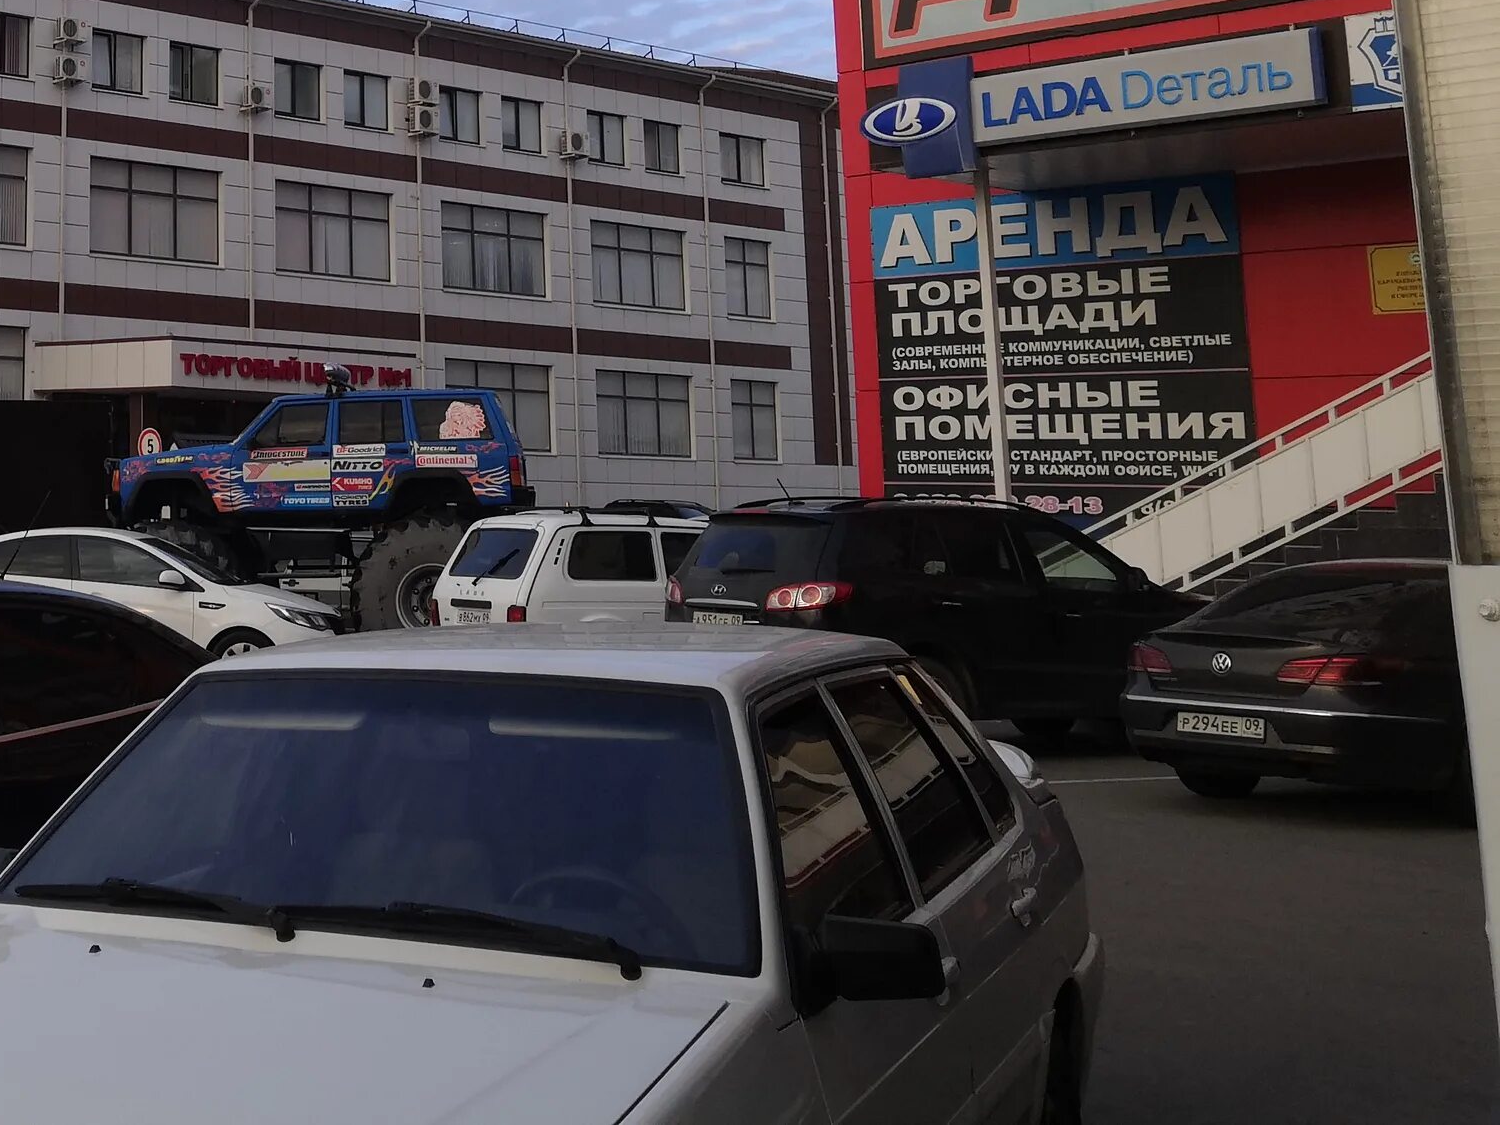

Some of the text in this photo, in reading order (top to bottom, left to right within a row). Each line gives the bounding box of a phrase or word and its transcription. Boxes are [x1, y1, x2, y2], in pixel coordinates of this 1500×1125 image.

[981, 75, 1112, 129] LADA
[879, 184, 1229, 269] АРЕНДА
[1009, 336, 1145, 353] КОММУНИКАЦИИ,
[1149, 334, 1232, 348] СВЕТЛЫЕ
[180, 353, 301, 382] ТОРГОВЫЙ
[892, 350, 1194, 372] ЗАЛЫ, КОМПЬТЕРНОЕ ОБЕСПЕЧЕНИЕ)
[147, 438, 154, 454] 5
[417, 455, 468, 467] Continental
[1010, 450, 1097, 464] СТАНДАРТ,
[1101, 450, 1218, 463] ПРОСТОРНЫЕ
[898, 463, 994, 477] ПОМЕЩЕНИЯ,
[1025, 464, 1035, 475] В
[1039, 464, 1111, 477] КАЖДОМ
[1114, 465, 1177, 479] ОФИСЕ,
[344, 477, 373, 485] KUMHO
[283, 497, 305, 505] TOYO
[1183, 715, 1260, 734] Р294ЕЕ 09
